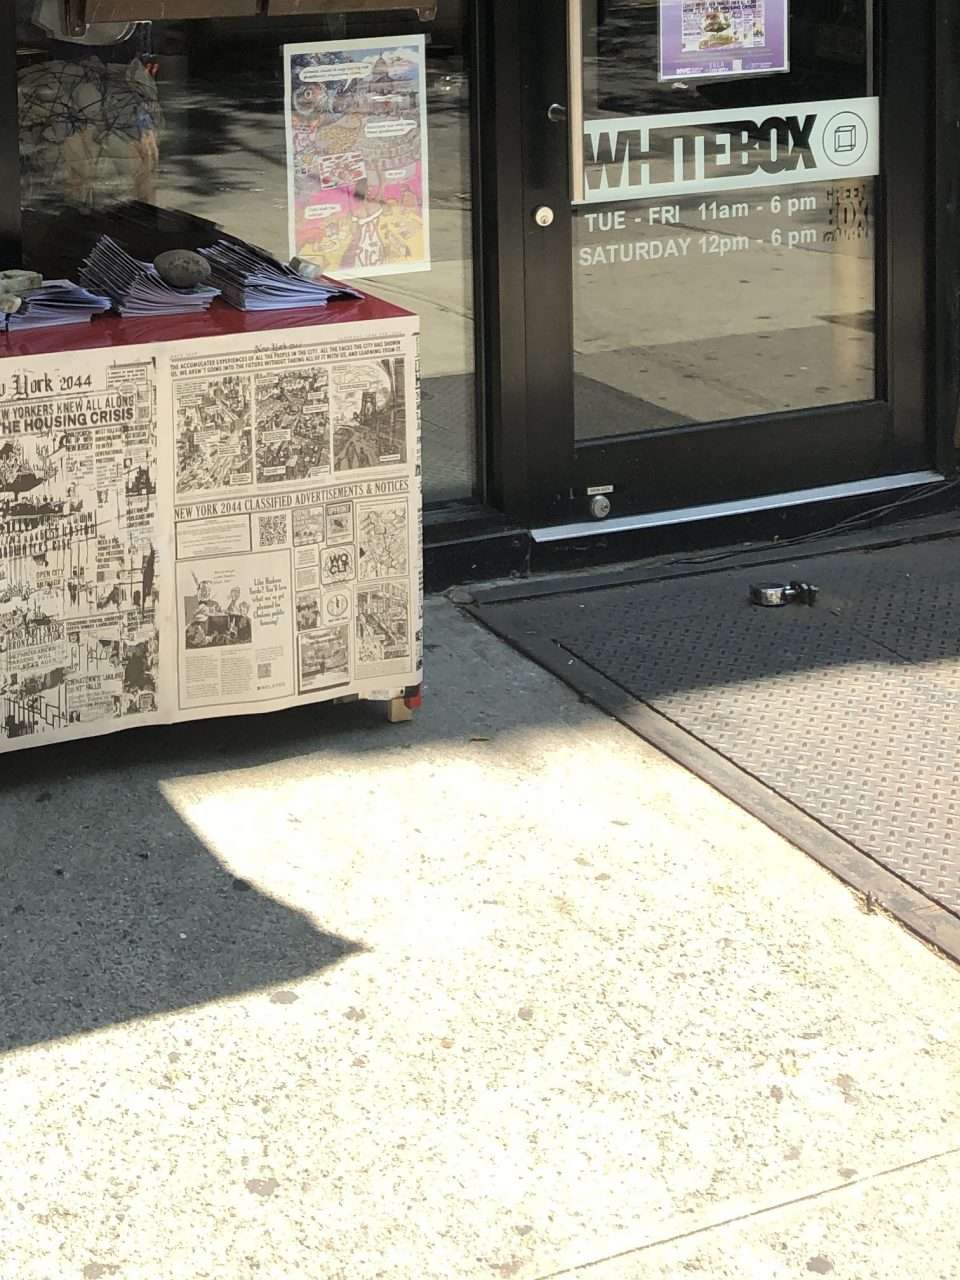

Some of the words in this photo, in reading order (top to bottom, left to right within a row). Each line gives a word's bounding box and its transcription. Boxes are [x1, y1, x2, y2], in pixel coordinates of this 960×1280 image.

[584, 211, 626, 233] TUE
[648, 205, 680, 226] FRI
[698, 200, 749, 222] 11am
[770, 196, 781, 213] 6
[788, 195, 816, 217] pm
[578, 237, 691, 267] SATURDAY
[698, 231, 749, 257] 12pm
[770, 227, 781, 246] 6
[788, 226, 816, 249] pm
[11, 372, 54, 401] York
[59, 374, 92, 391] 2044
[12, 404, 54, 420] YORKERS
[57, 400, 83, 414] KNEW
[86, 397, 103, 411] ALL
[106, 394, 134, 409] ALONG
[24, 413, 88, 432] HOUSING
[90, 407, 134, 424] CRISIS
[174, 507, 191, 520] NEW
[195, 503, 218, 517] YORK
[220, 499, 241, 514] 2044
[244, 494, 293, 512] CLASSIFIED
[295, 483, 363, 505] ADVERTISEMENTS
[375, 479, 409, 494] NOTICES
